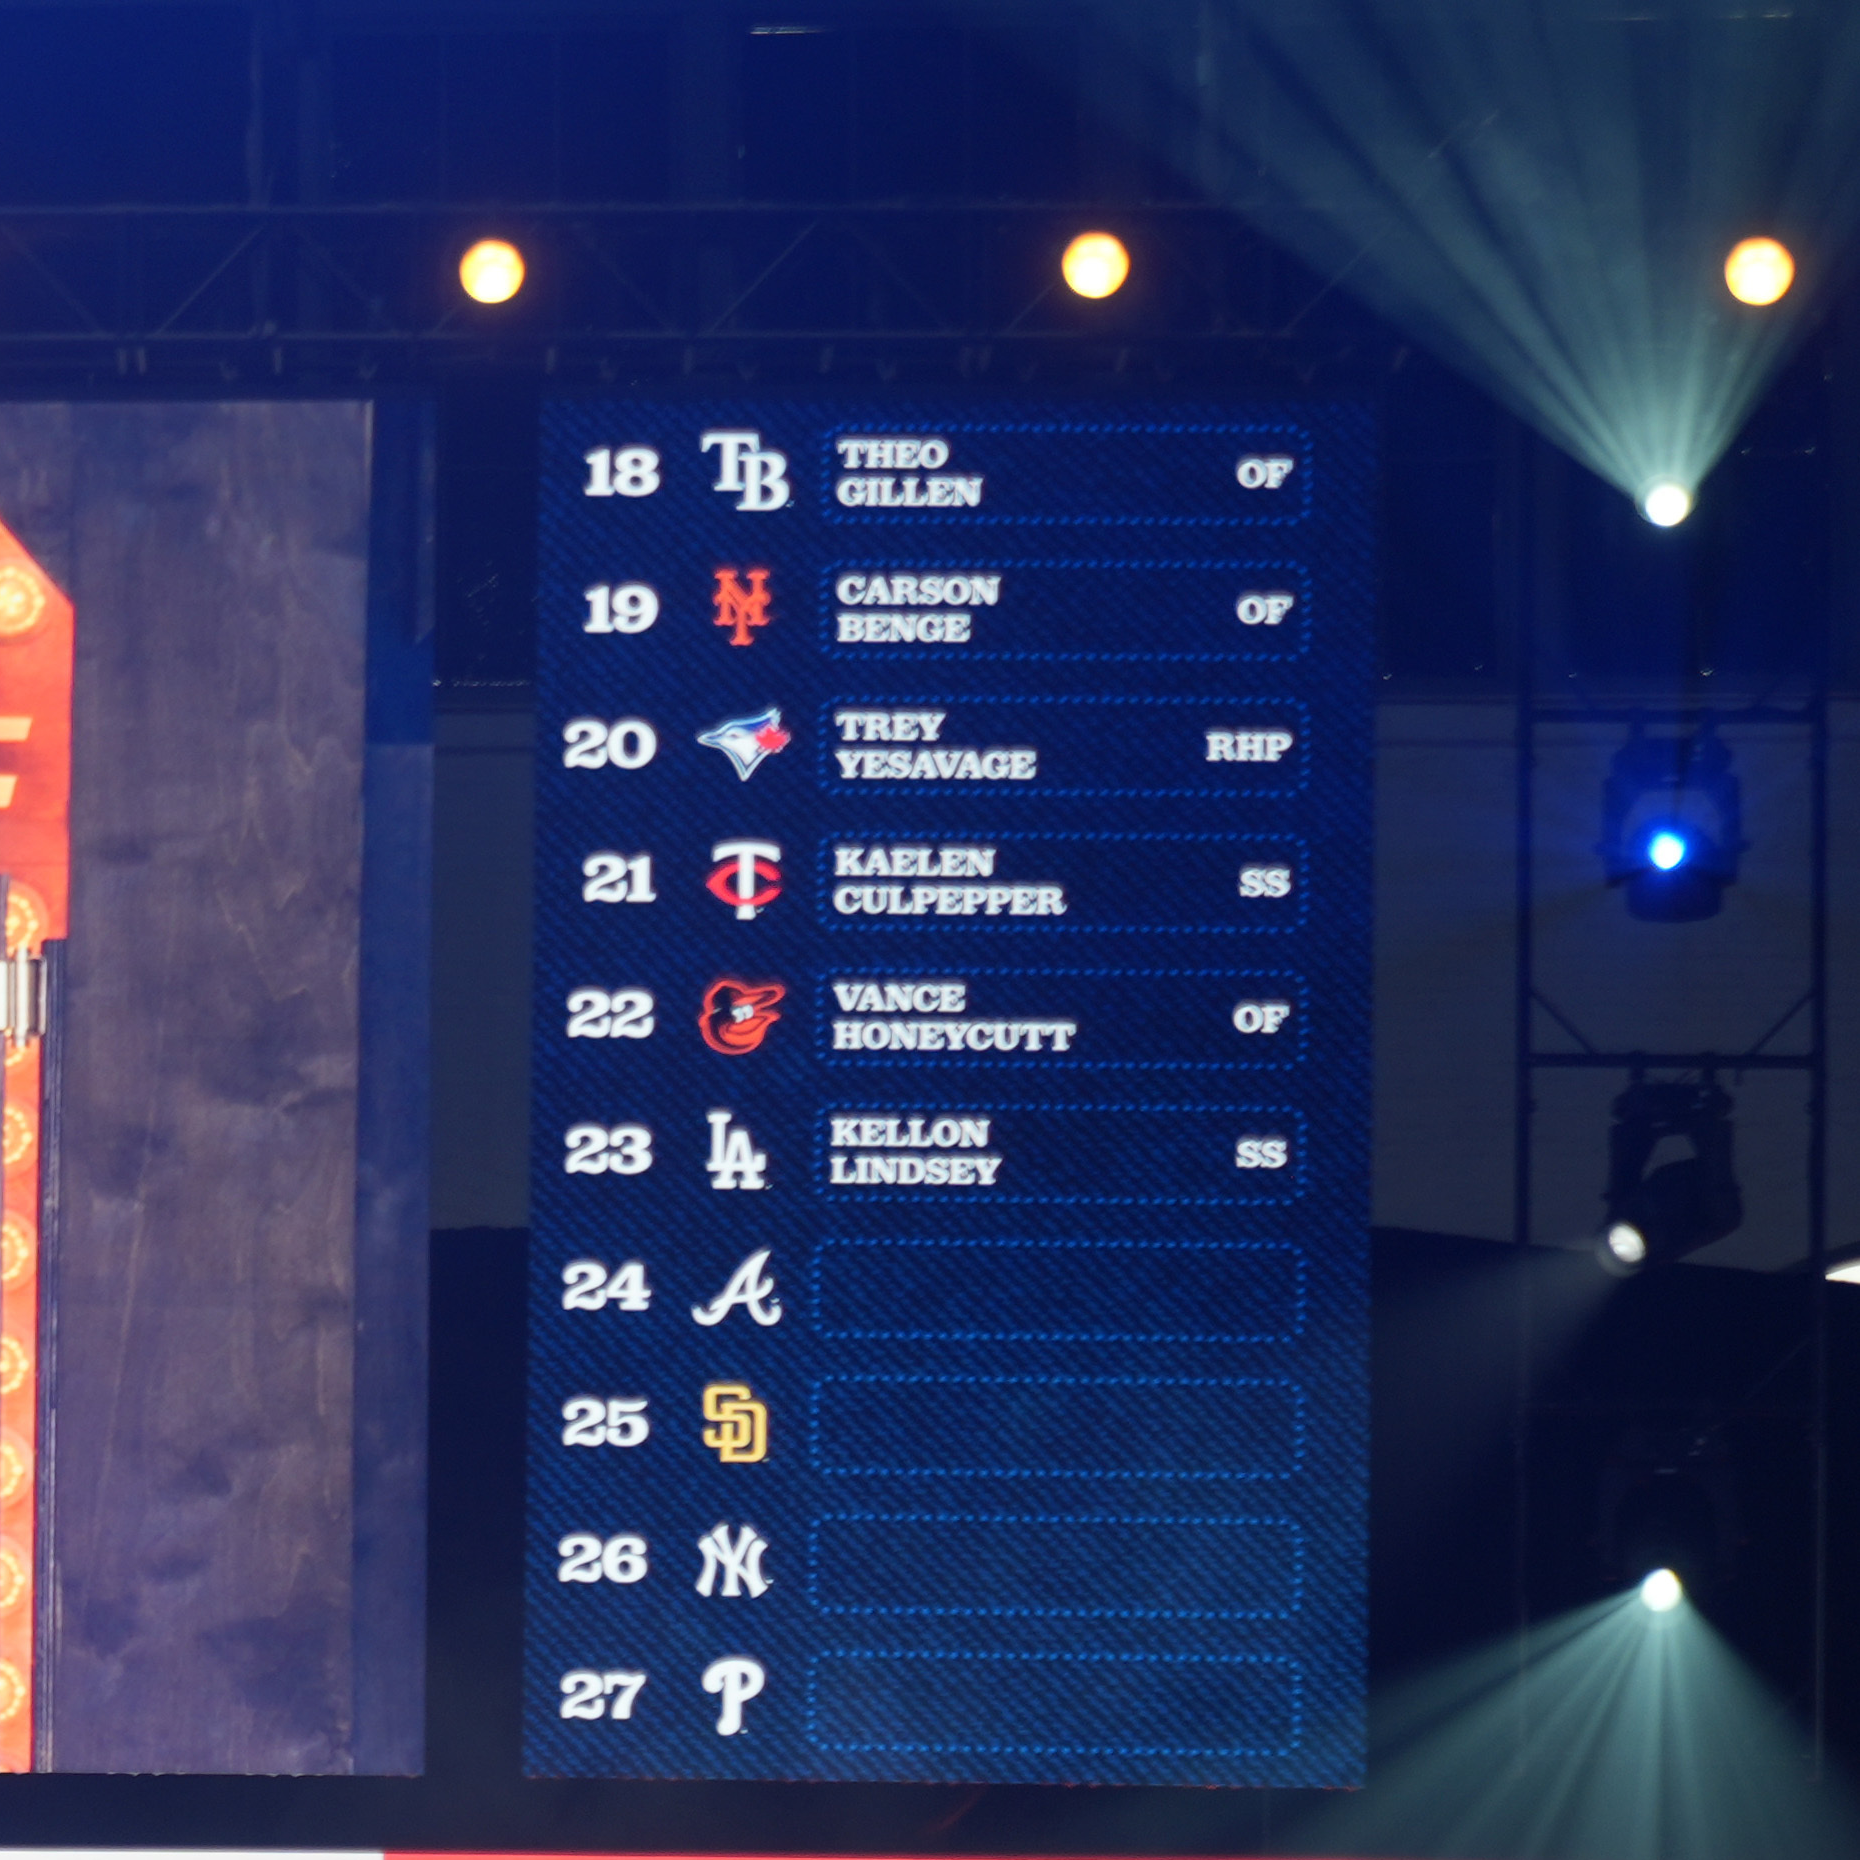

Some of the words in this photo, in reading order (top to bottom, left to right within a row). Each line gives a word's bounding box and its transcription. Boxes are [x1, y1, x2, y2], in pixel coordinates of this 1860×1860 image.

[837, 438, 950, 470] THEO
[584, 446, 661, 498] 18
[701, 431, 790, 512] TB
[1236, 458, 1294, 489] OF
[835, 476, 984, 507] GILLEN
[836, 574, 1002, 606] CARSON
[583, 583, 660, 634] 19
[1236, 594, 1294, 625] OF
[836, 612, 971, 643] BENGE
[835, 710, 946, 742] TREY
[563, 719, 658, 770] 20
[1205, 731, 1293, 762] RHP
[834, 748, 1037, 780] YESAVAGE
[834, 846, 997, 877] KAELEN
[582, 853, 657, 903] 21
[1238, 867, 1292, 898] SS
[832, 884, 1068, 916] CULPEPPER
[566, 988, 655, 1039] 22
[832, 982, 966, 1013] VANCE
[1232, 1003, 1290, 1034] OF
[832, 1019, 1077, 1052] HONEYCUTT
[830, 1116, 991, 1148] KELLON
[564, 1124, 653, 1175] 23
[705, 1110, 766, 1190] LA
[1235, 1139, 1288, 1169] SS
[829, 1154, 1003, 1186] LINDSEY
[562, 1260, 652, 1311] 24
[691, 1249, 783, 1327] A
[561, 1396, 650, 1447] 25
[702, 1383, 768, 1463] SD
[557, 1533, 648, 1584] 26
[695, 1523, 771, 1599] NY
[559, 1670, 647, 1720] 27
[701, 1656, 766, 1736] P
